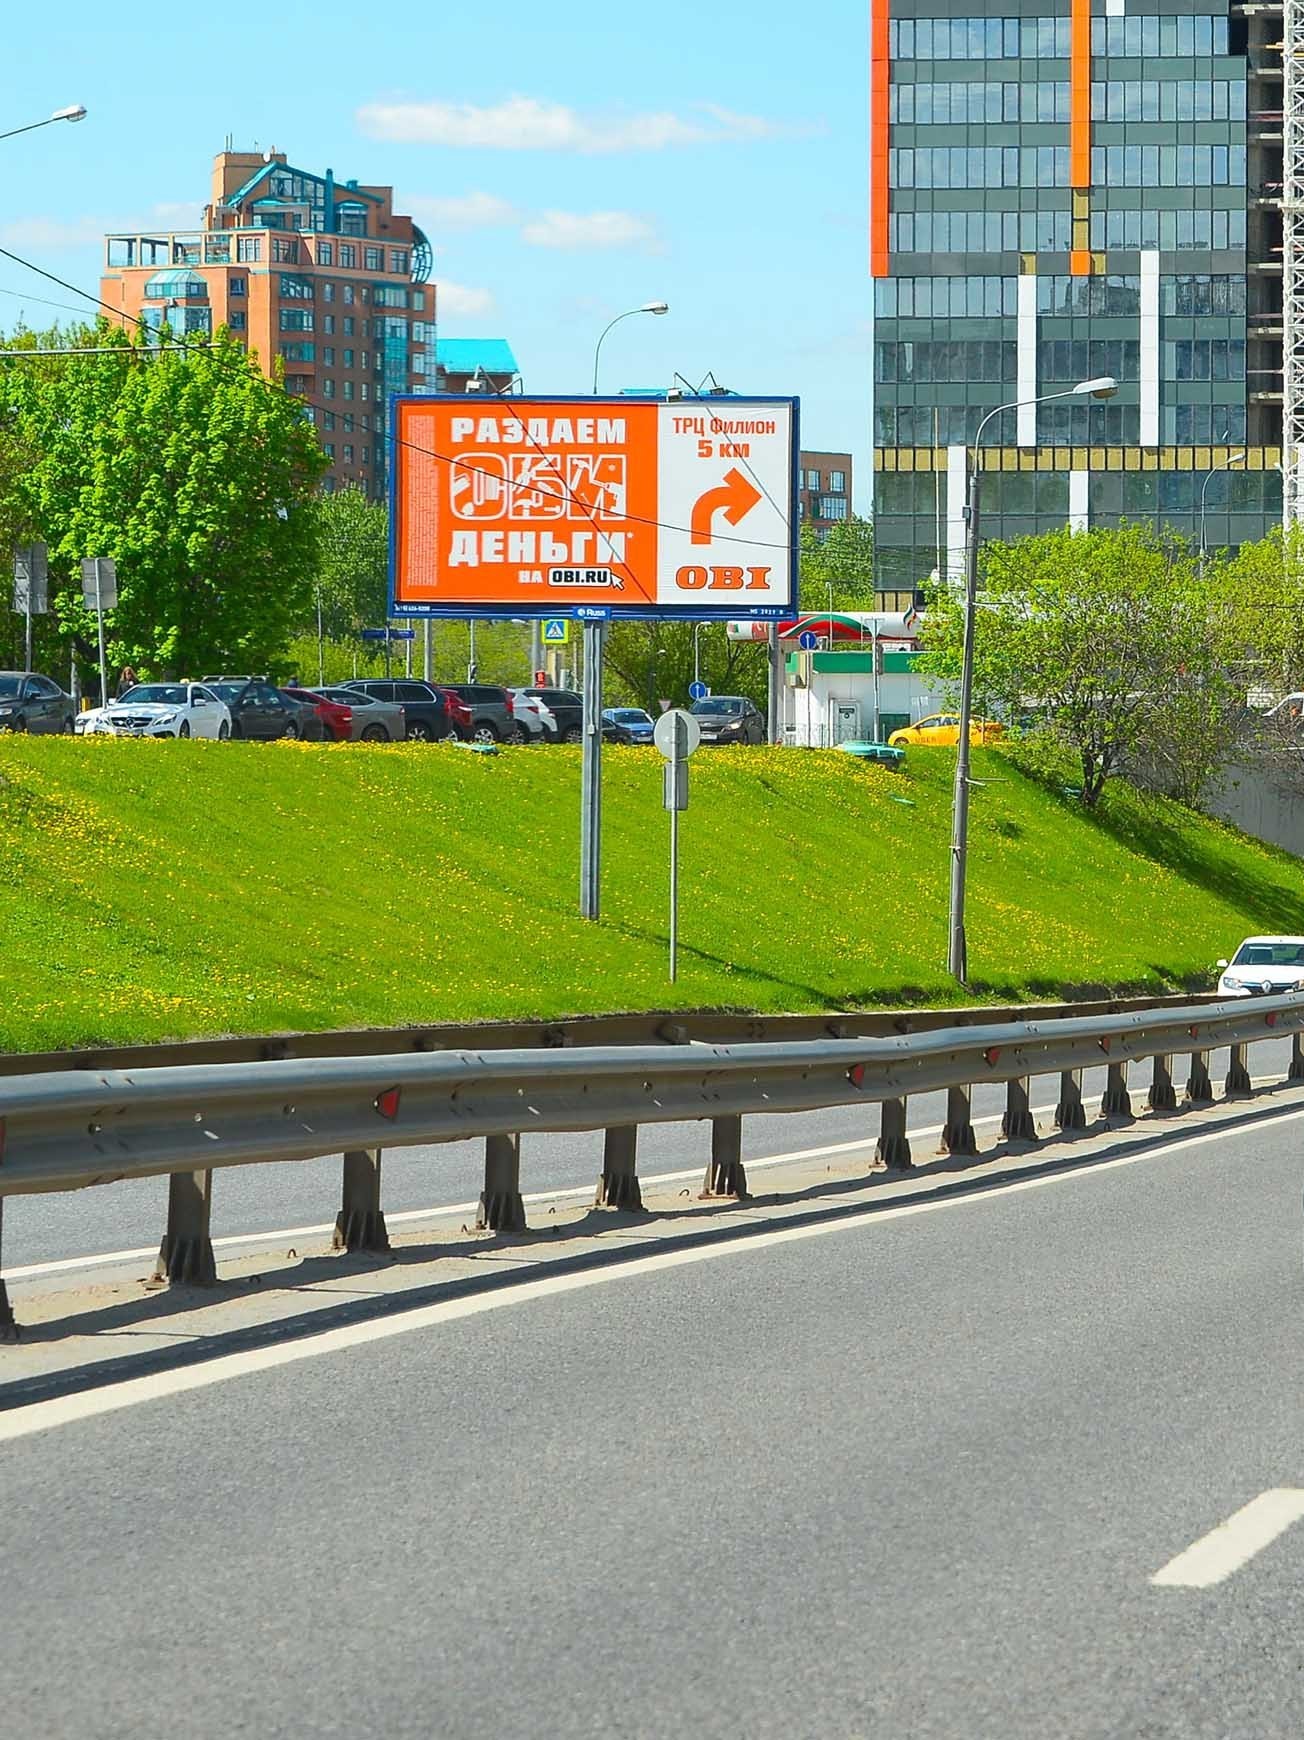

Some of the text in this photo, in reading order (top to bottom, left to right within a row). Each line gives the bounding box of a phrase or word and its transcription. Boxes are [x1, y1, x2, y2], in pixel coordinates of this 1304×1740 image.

[451, 417, 626, 447] РАЗДАЕМ
[672, 417, 705, 437] ТРЦ
[698, 440, 713, 458] 5
[552, 570, 609, 584] OBI.RU
[675, 565, 772, 590] OBI
